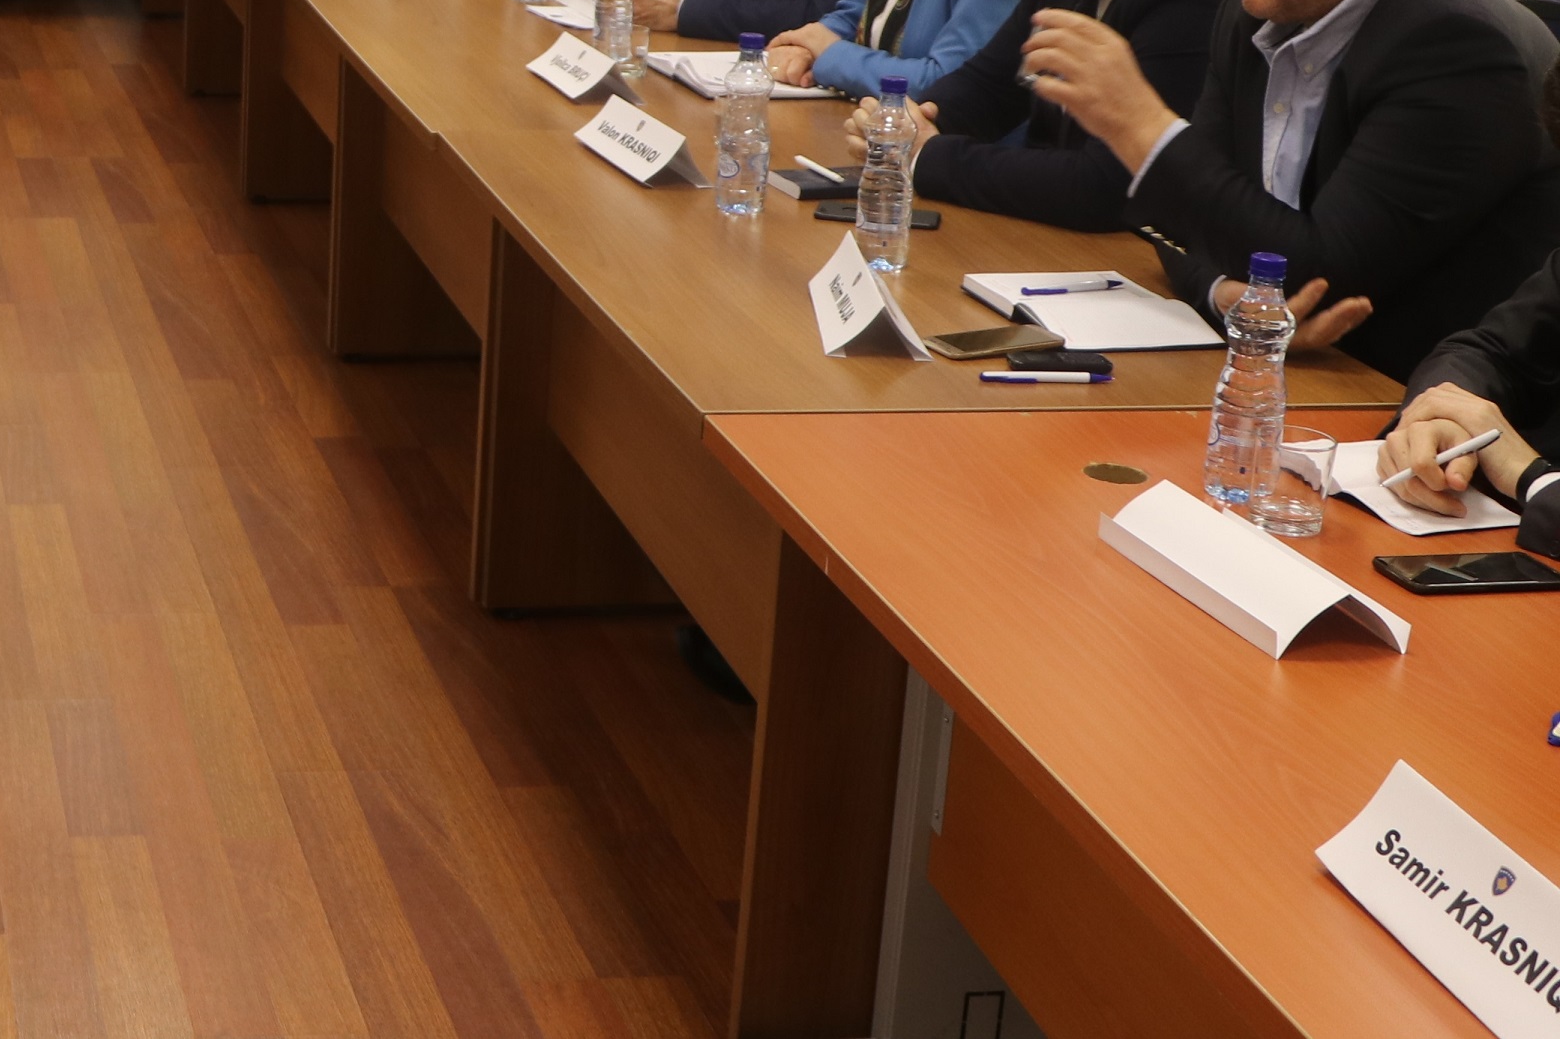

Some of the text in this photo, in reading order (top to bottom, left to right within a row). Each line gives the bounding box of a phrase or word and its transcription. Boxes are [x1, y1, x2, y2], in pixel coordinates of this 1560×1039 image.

[597, 120, 662, 164] Valon KRASNIQI
[1375, 829, 1560, 1014] Samir KRASNIQ
